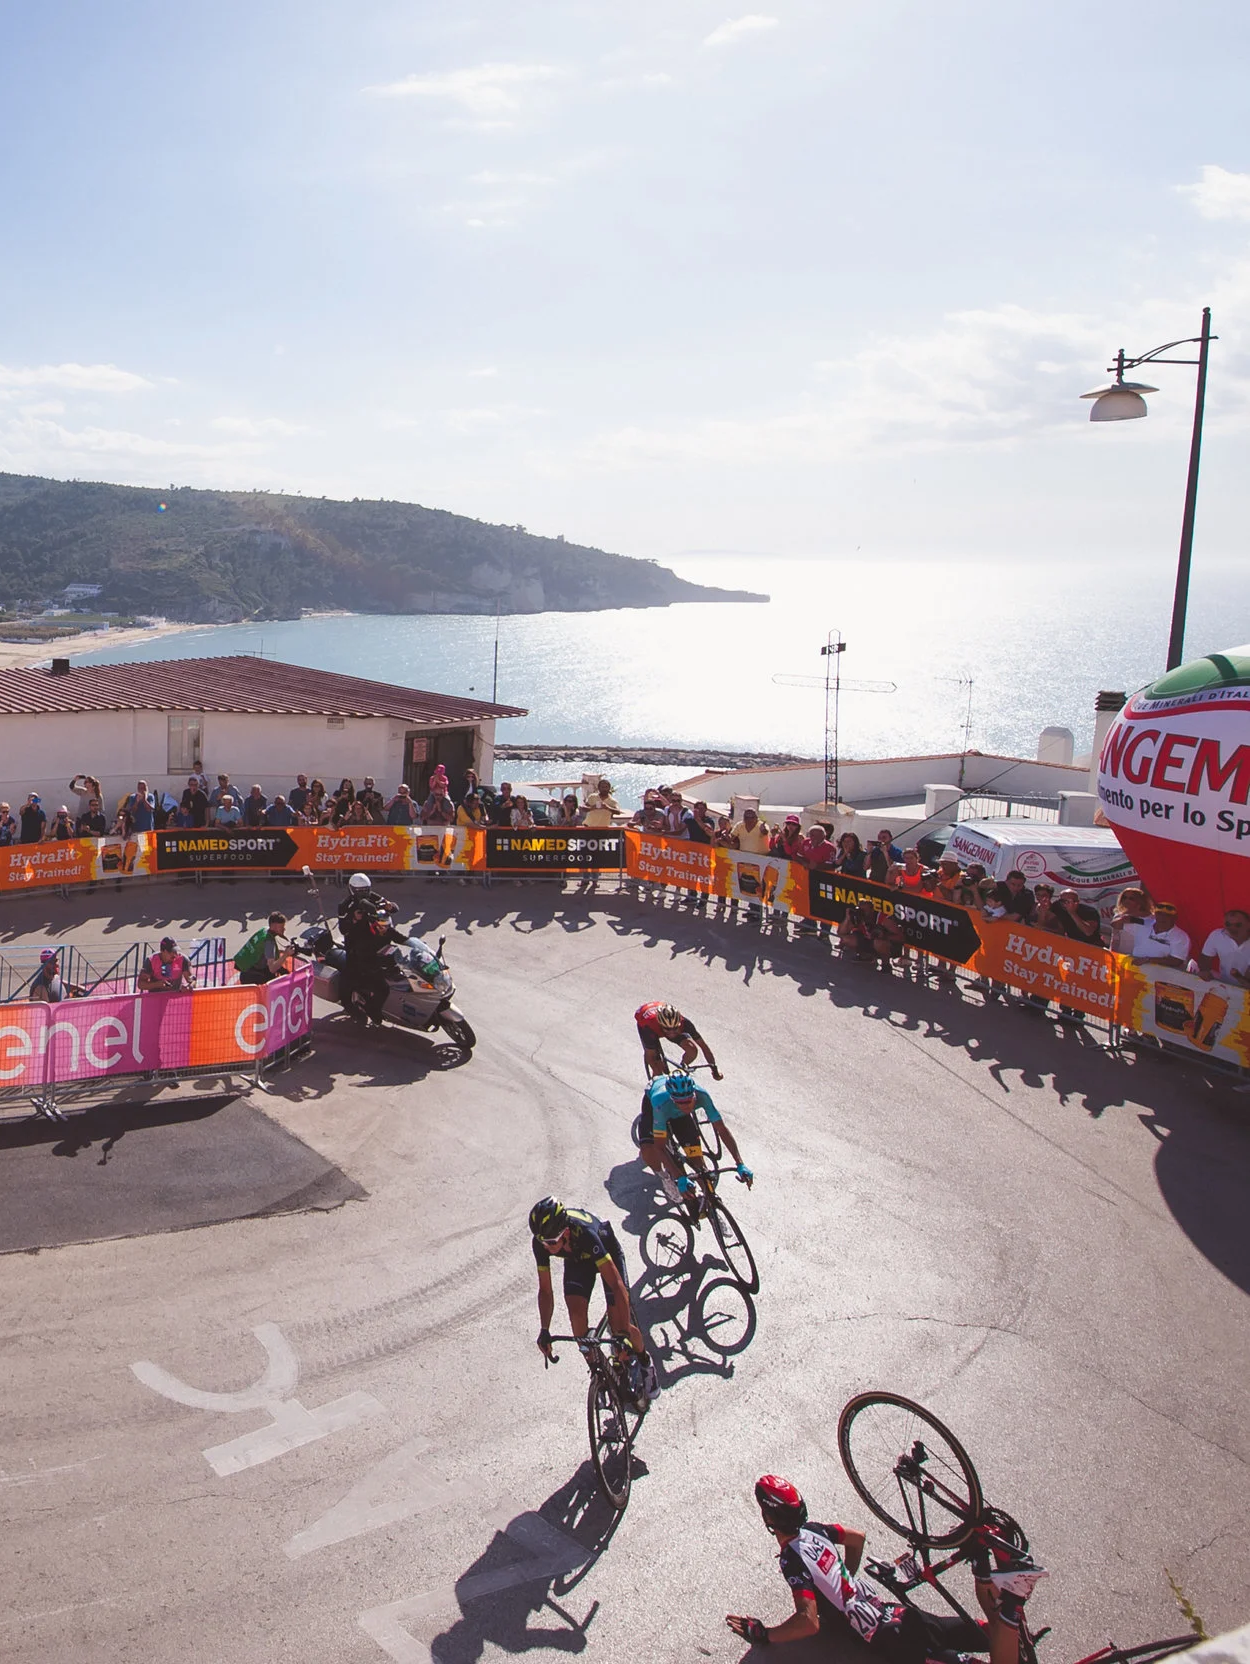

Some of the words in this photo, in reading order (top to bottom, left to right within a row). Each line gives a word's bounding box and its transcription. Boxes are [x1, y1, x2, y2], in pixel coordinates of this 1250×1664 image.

[1100, 721, 1250, 806] NGEM
[1140, 798, 1175, 820] per
[1183, 802, 1206, 826] lo
[179, 839, 275, 852] NAMEDSPORT
[316, 834, 388, 850] HydraFit
[511, 838, 619, 851] NAMEDSPORT
[952, 836, 996, 865] SANGEMINI
[9, 848, 77, 869] HydraFit
[189, 853, 252, 861] SUPERFOOD
[315, 853, 341, 864] Stay
[345, 852, 393, 863] Trained!
[522, 854, 593, 862] SUPERFOOD
[639, 841, 711, 868] HydraFit
[9, 870, 33, 882] Stay
[36, 867, 82, 881] Trained!
[638, 859, 664, 878] Stay
[1005, 933, 1108, 983] HydraFit
[1003, 959, 1039, 984] Stay
[1043, 972, 1116, 1009] Trained!
[234, 968, 312, 1055] enel
[803, 1535, 824, 1561] UAE
[847, 1600, 882, 1635] 202
